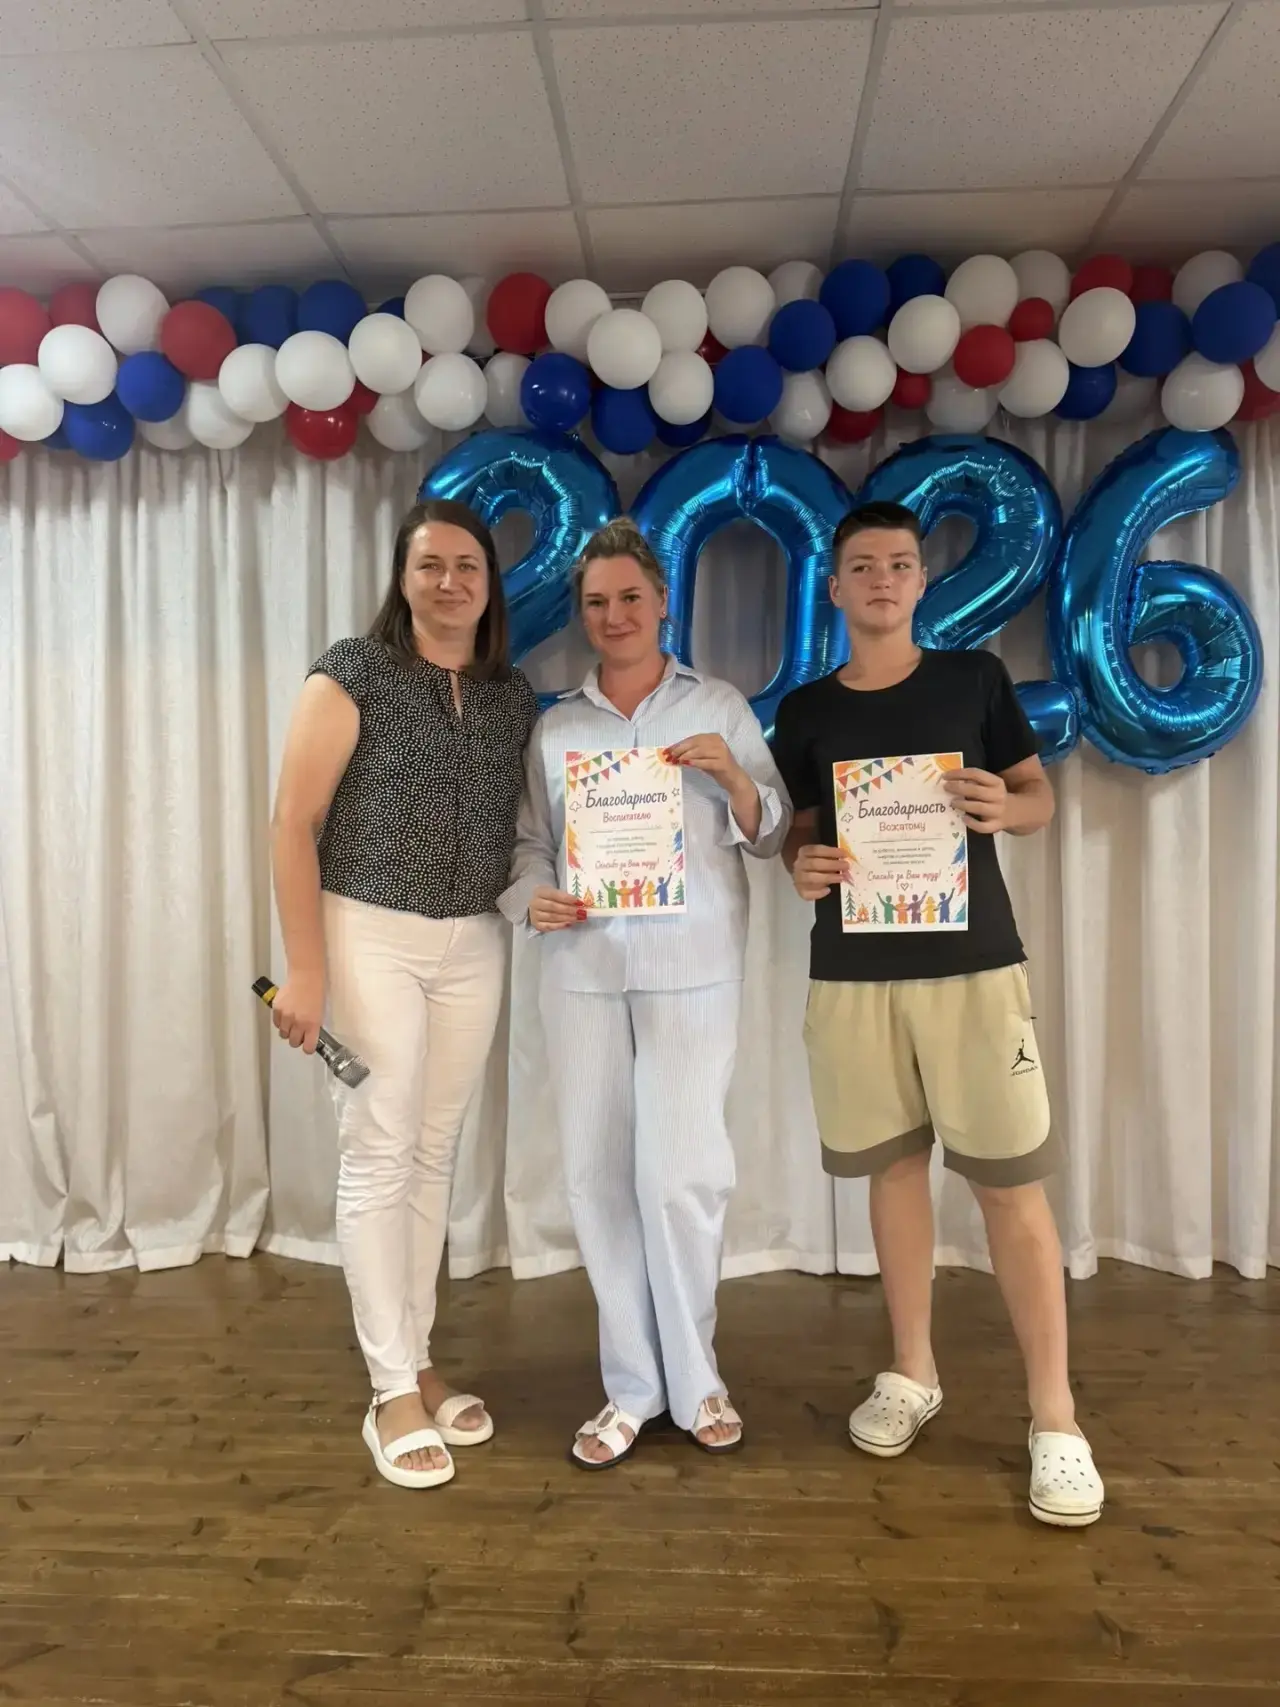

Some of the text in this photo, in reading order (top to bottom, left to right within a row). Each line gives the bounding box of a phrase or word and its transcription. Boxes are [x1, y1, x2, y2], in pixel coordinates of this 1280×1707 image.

[418, 425, 1263, 774] 2026
[585, 788, 668, 810] Благодарность
[857, 799, 946, 820] Благодарность
[603, 812, 652, 824] Воспитателю
[879, 821, 926, 832] Вожатому
[867, 870, 894, 881] Спасибо
